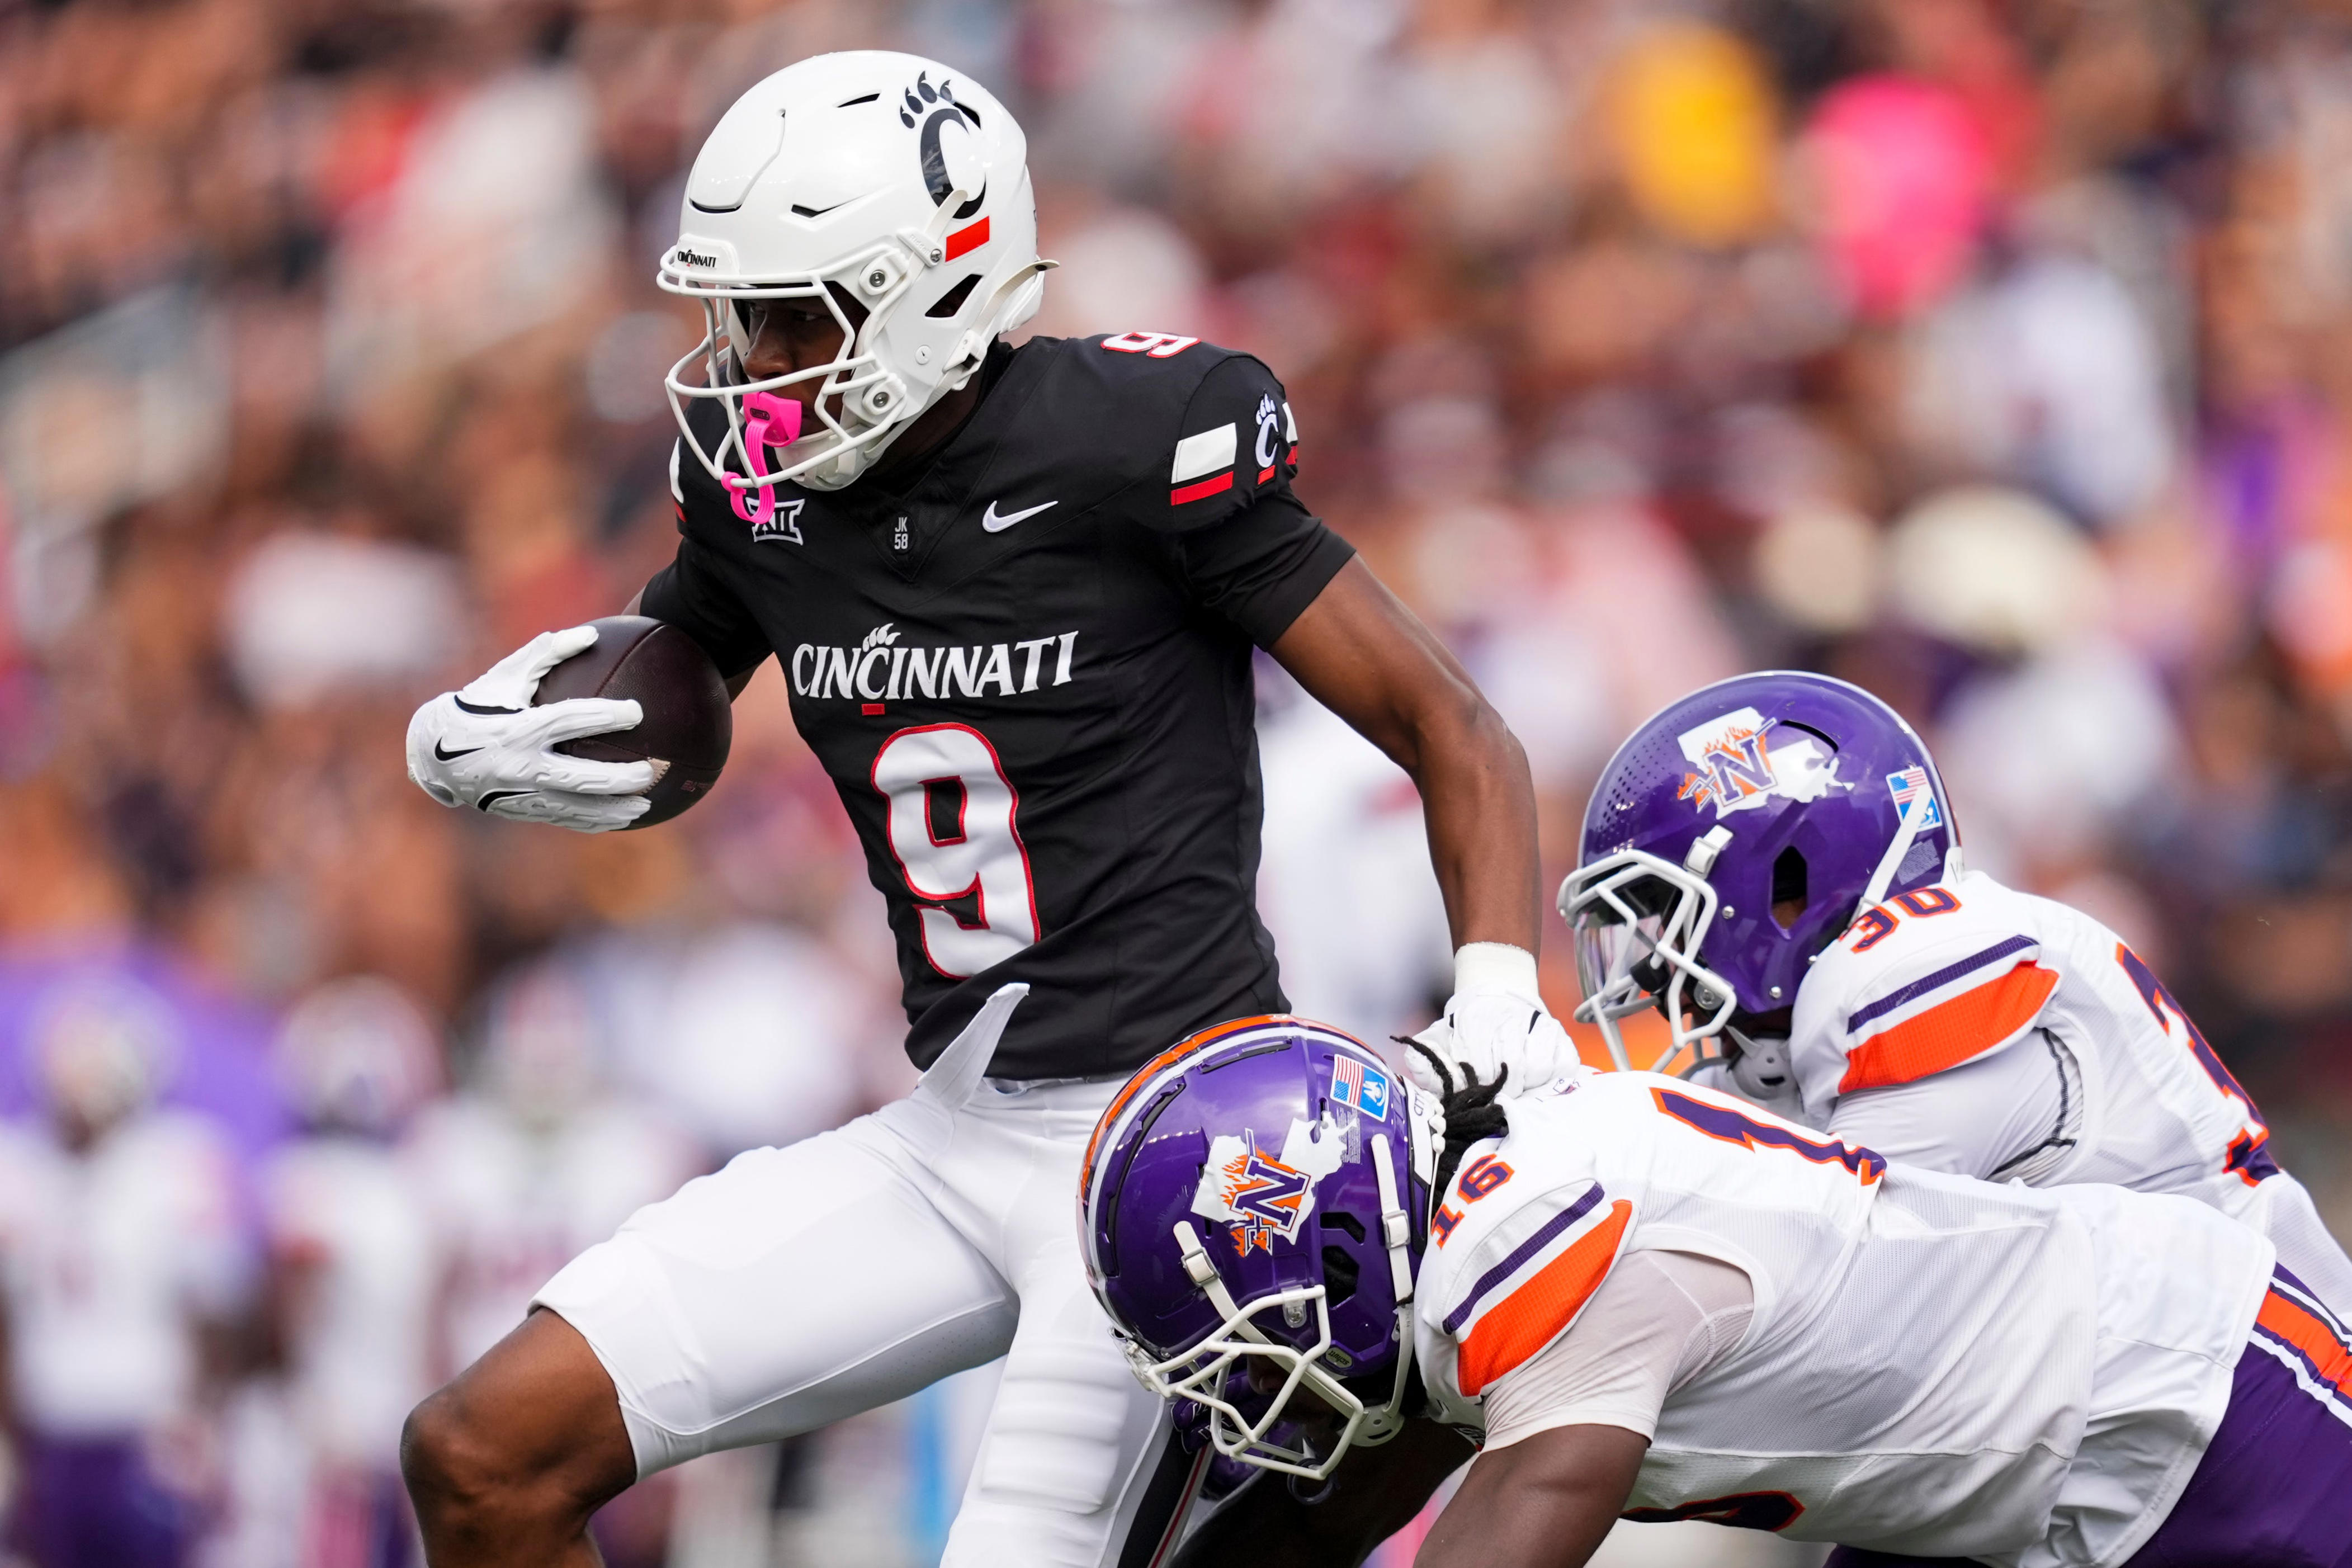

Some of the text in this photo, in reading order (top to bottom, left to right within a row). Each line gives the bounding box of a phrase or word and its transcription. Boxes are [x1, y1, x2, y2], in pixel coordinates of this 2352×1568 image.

[678, 249, 716, 268] CINCINNATI
[894, 533, 908, 550] 58
[895, 516, 908, 532] JK
[792, 626, 1079, 700] CINCINNATI
[871, 721, 1041, 980] 9
[1838, 887, 1962, 954] 30
[1230, 1155, 1311, 1232] N
[1430, 1153, 1515, 1250] 16
[1328, 1350, 1349, 1365] schutt
